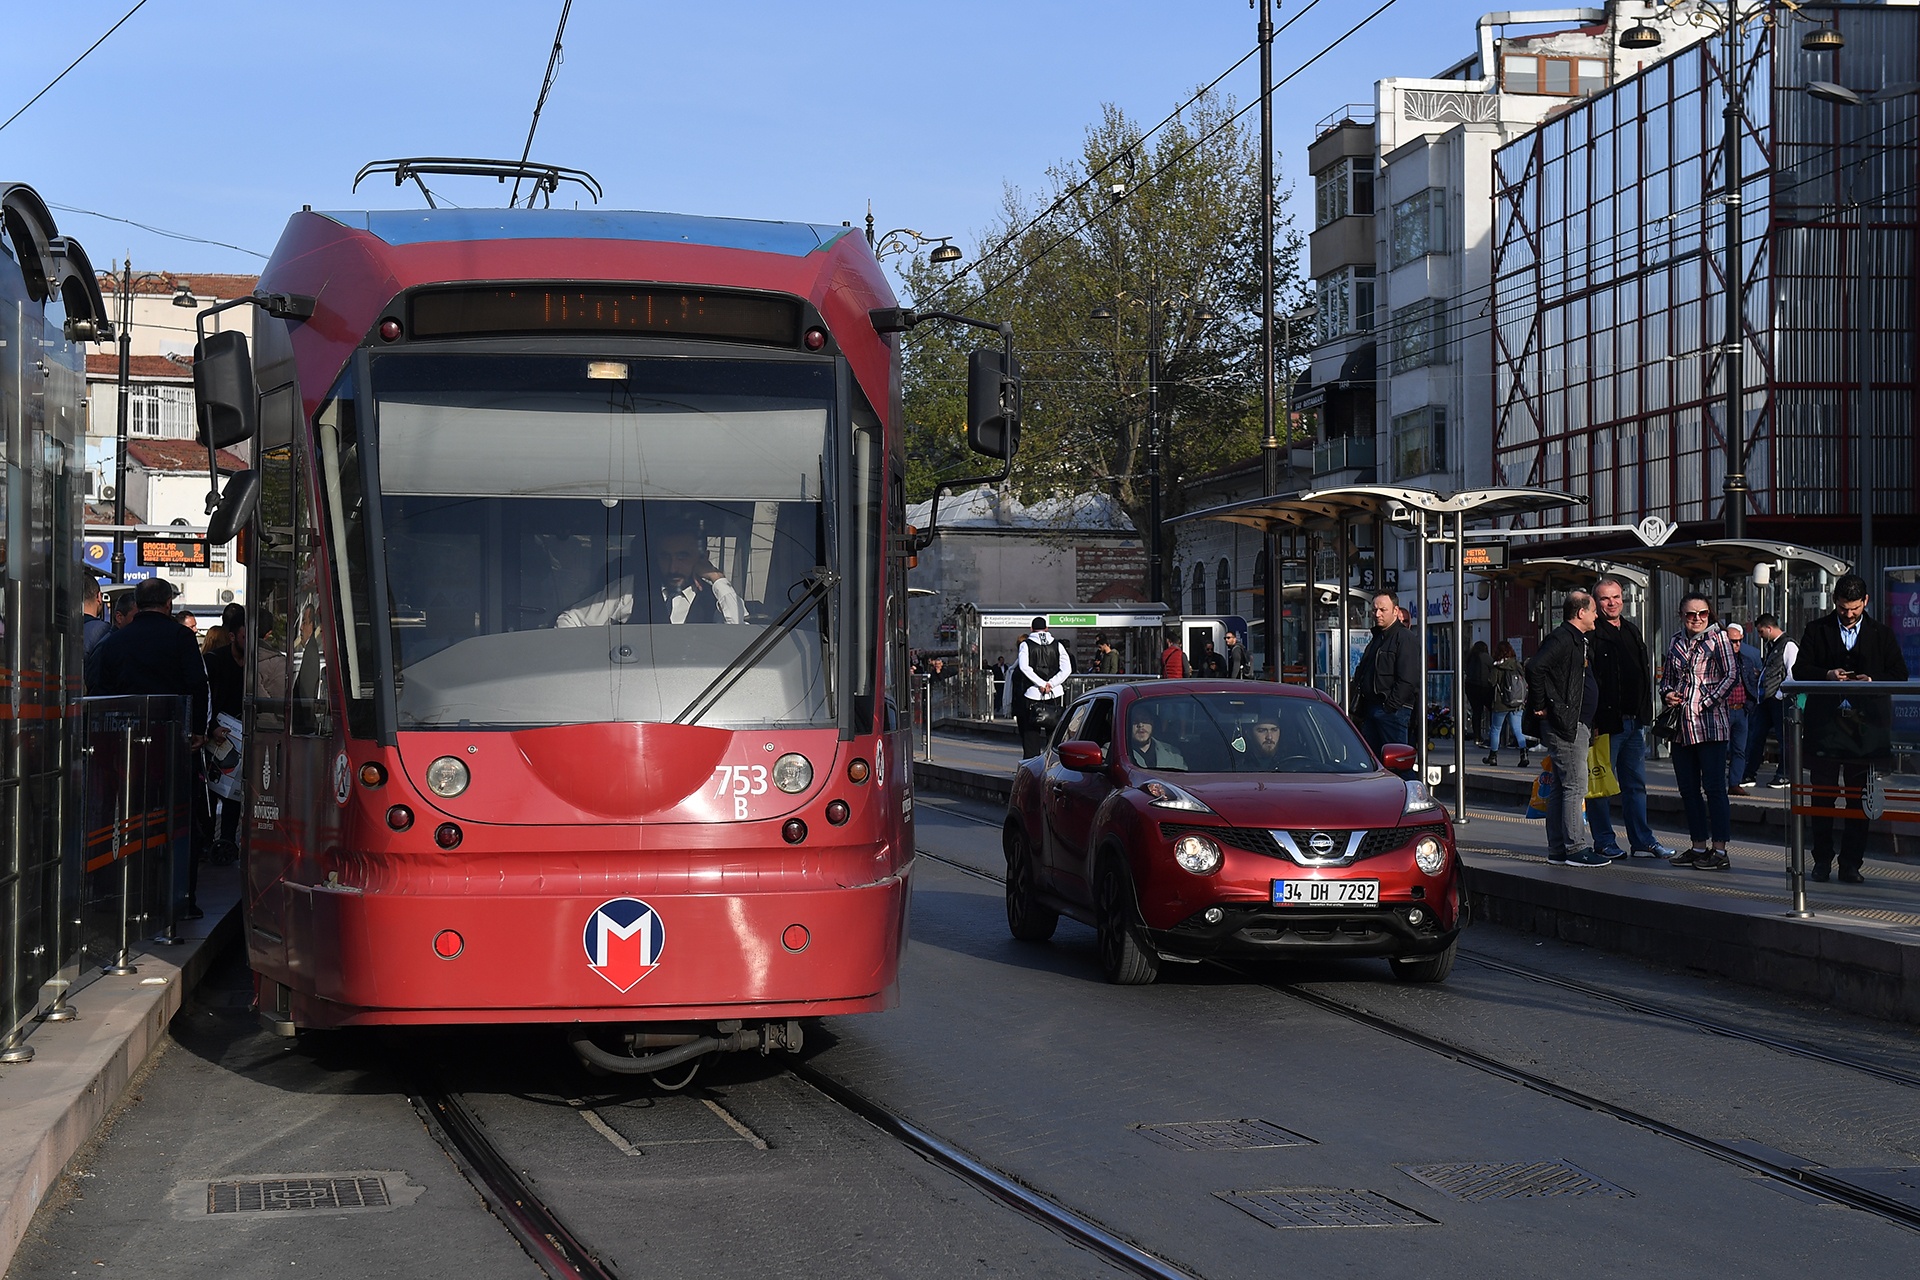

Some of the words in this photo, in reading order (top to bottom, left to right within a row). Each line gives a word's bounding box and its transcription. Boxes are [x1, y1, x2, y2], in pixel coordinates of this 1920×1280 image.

[1463, 556, 1491, 564] STANBUL
[715, 764, 768, 797] 753
[734, 796, 749, 820] B
[1284, 883, 1302, 900] 34
[1310, 884, 1329, 901] DH
[1339, 884, 1375, 901] 7292
